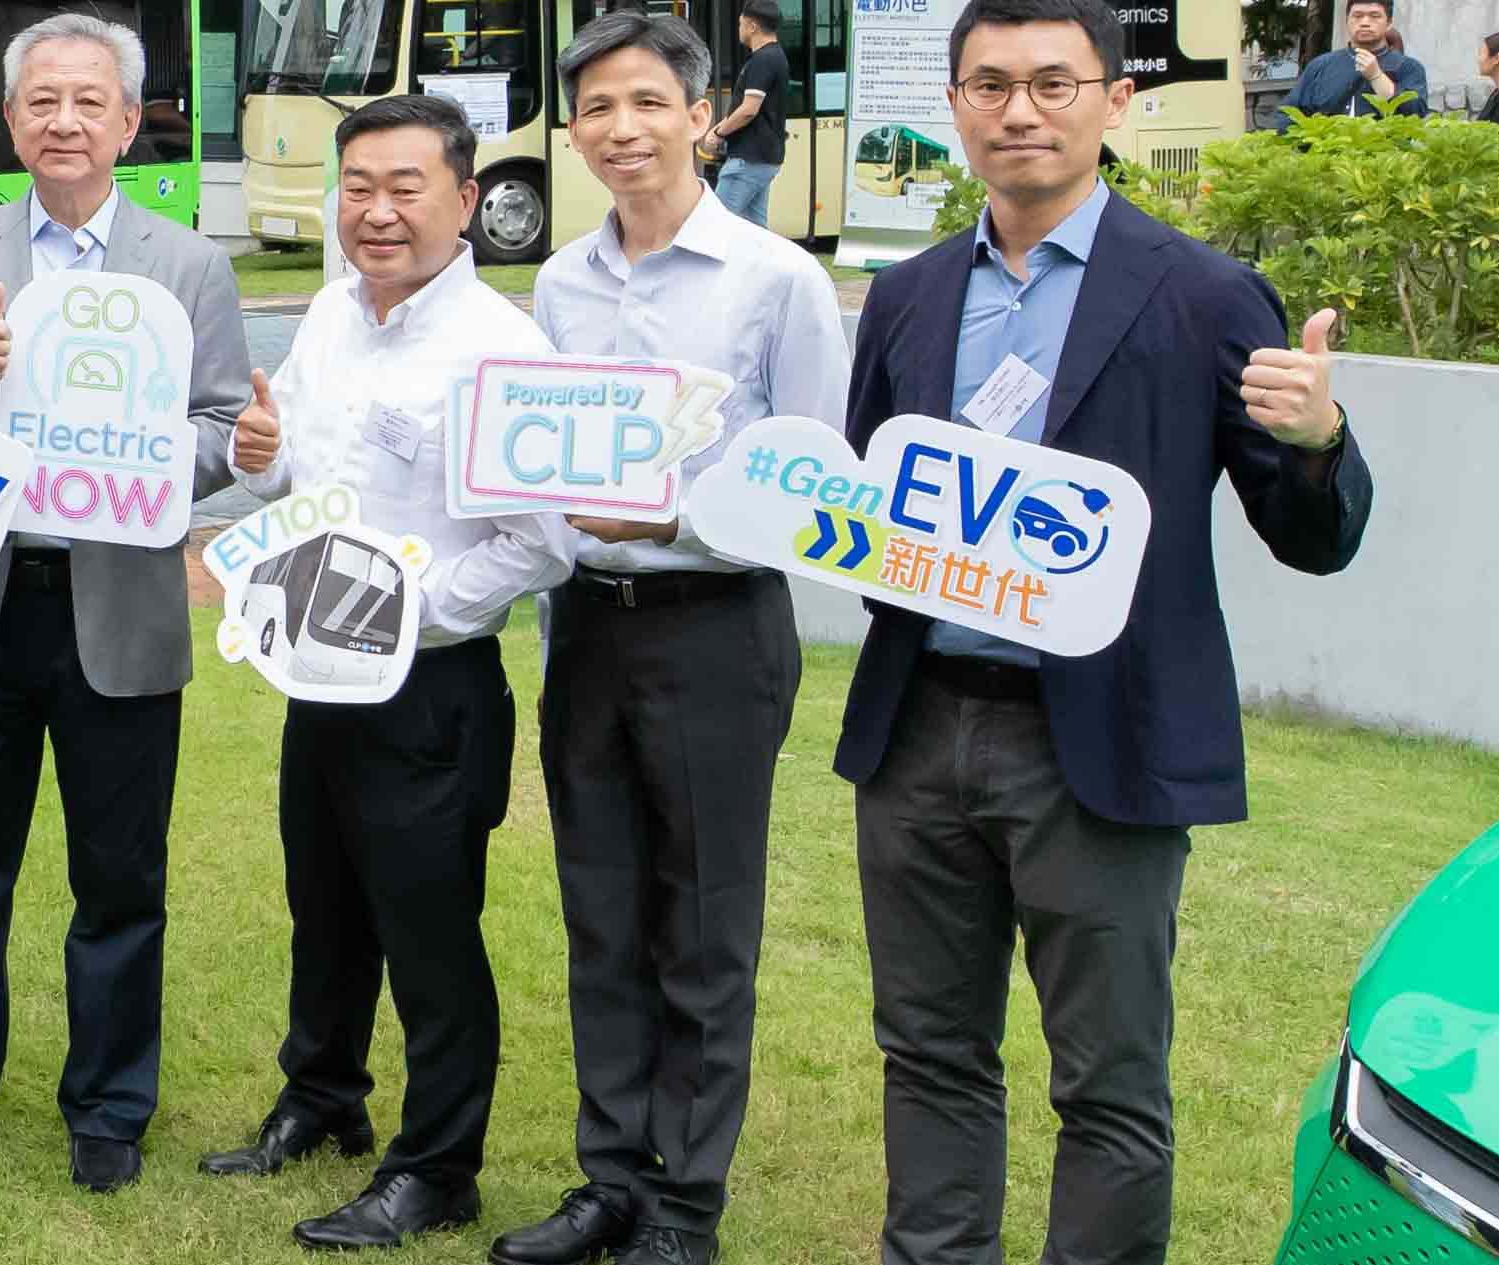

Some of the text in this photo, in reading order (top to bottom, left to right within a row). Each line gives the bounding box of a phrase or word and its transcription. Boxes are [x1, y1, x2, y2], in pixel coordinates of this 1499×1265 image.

[1112, 5, 1169, 24] amics
[62, 286, 140, 333] GO
[504, 380, 645, 408] Powered by
[9, 411, 173, 462] Electric
[504, 413, 663, 485] CLP
[213, 487, 352, 572] EV100
[878, 536, 1050, 628] 新世代
